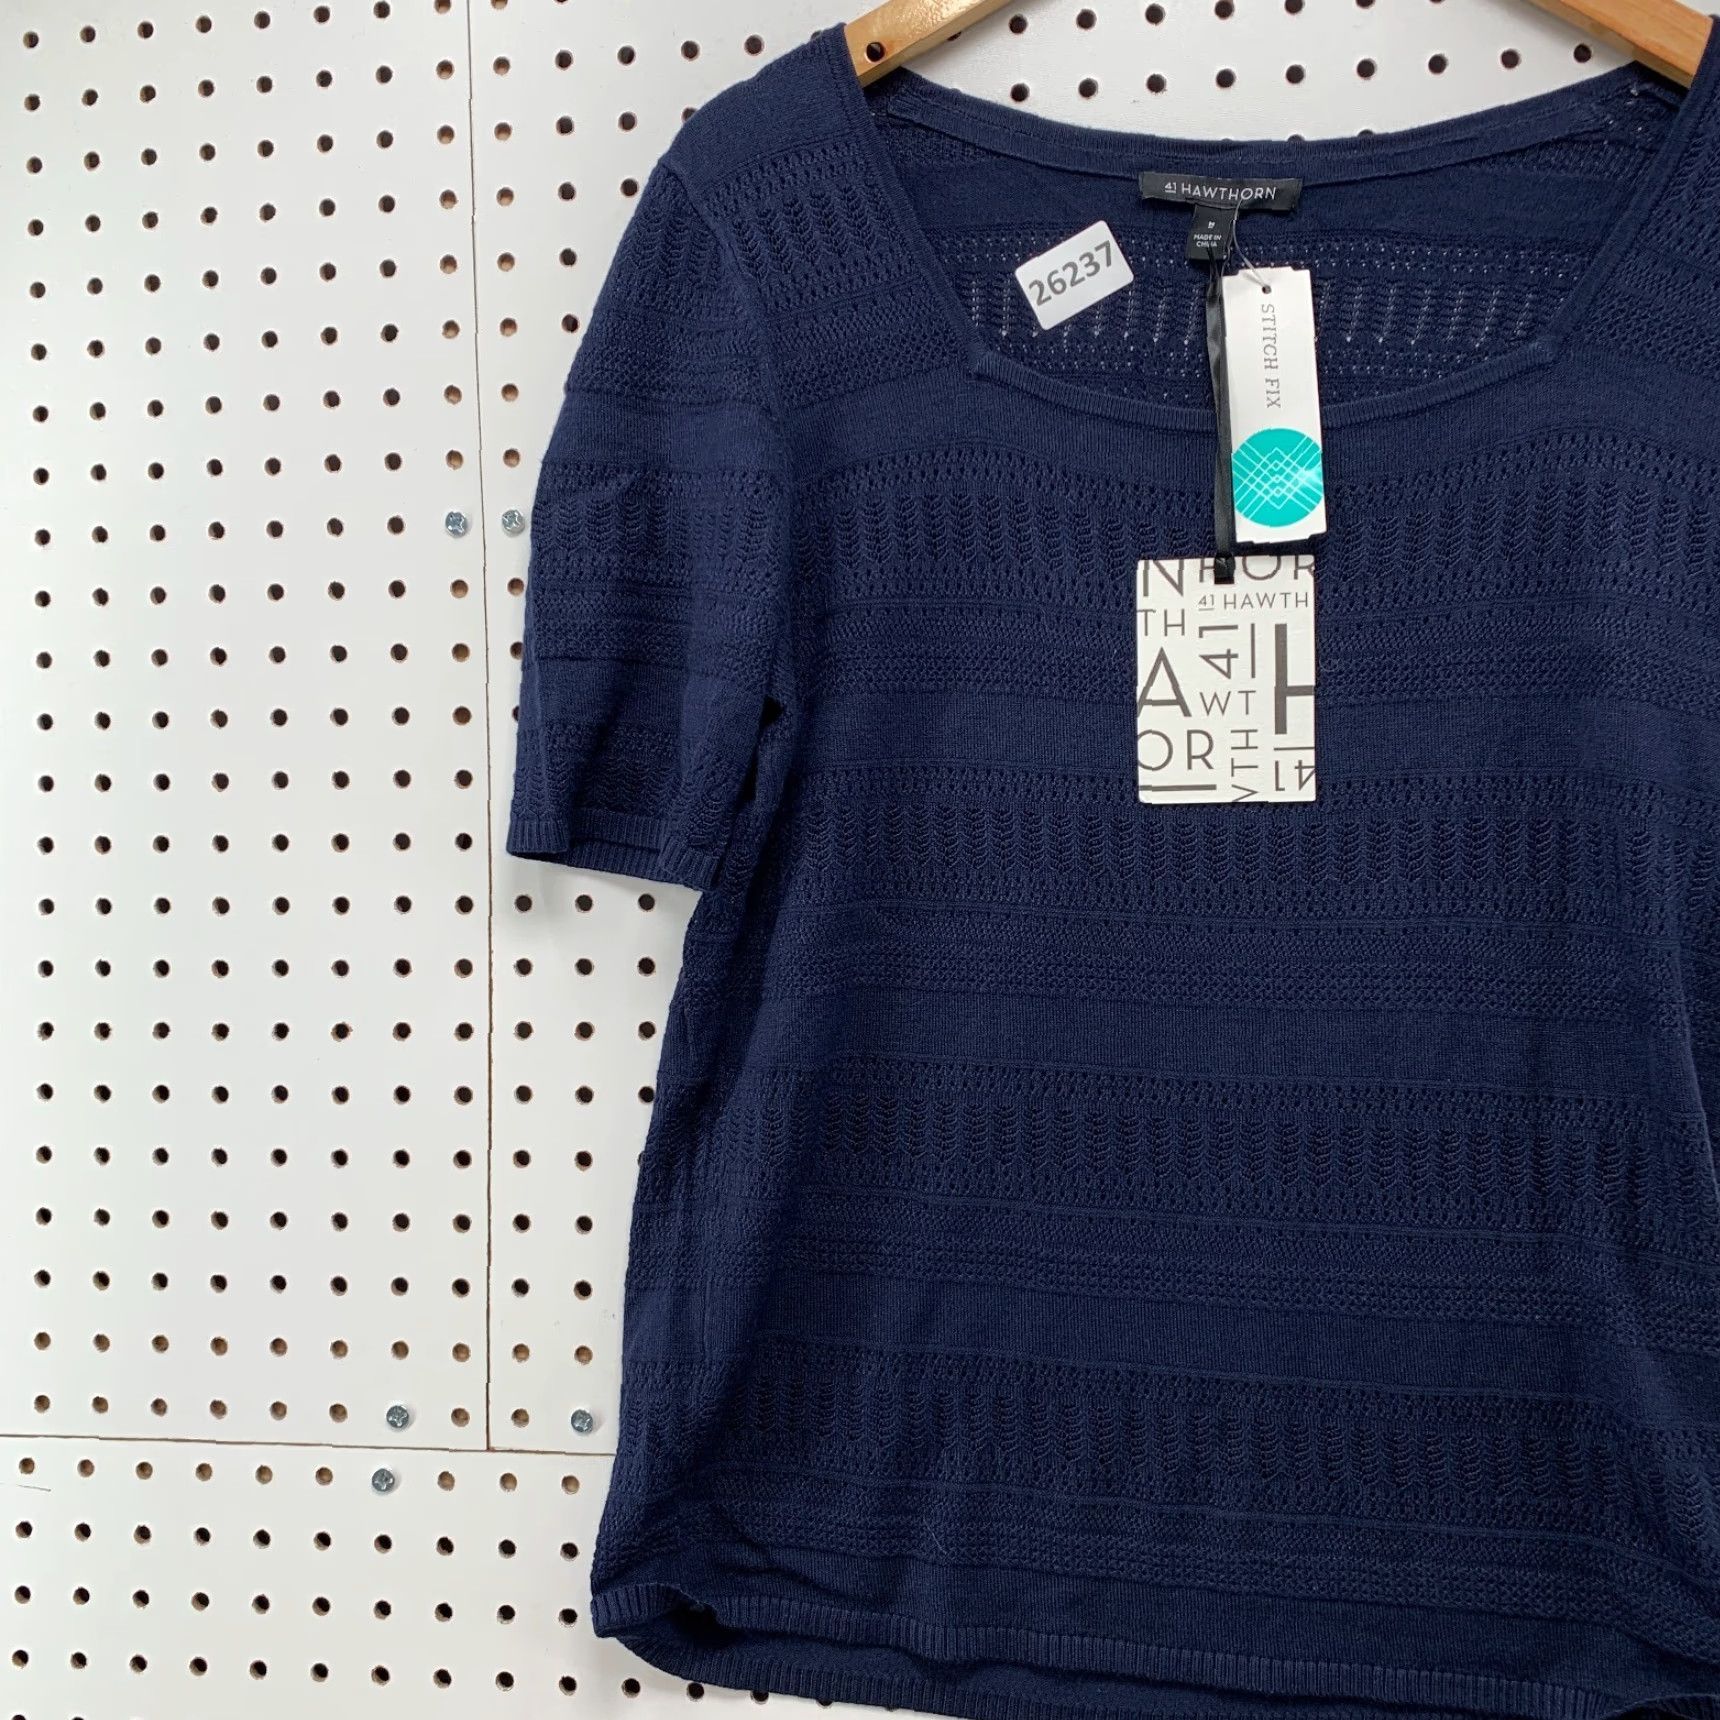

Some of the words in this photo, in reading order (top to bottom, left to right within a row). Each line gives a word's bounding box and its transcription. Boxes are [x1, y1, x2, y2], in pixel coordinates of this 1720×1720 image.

[1164, 181, 1177, 194] 41
[1181, 183, 1277, 200] HAWTHORN
[1193, 233, 1213, 241] MADE
[1029, 240, 1114, 306] 26237
[1261, 303, 1279, 370] STITCH
[1265, 377, 1281, 409] FIX
[1198, 594, 1215, 611] 41
[1223, 592, 1309, 609] HAWTH
[1137, 608, 1186, 637] TH
[1137, 646, 1193, 717] A
[1199, 690, 1257, 717] WT
[1137, 729, 1215, 772] OR
